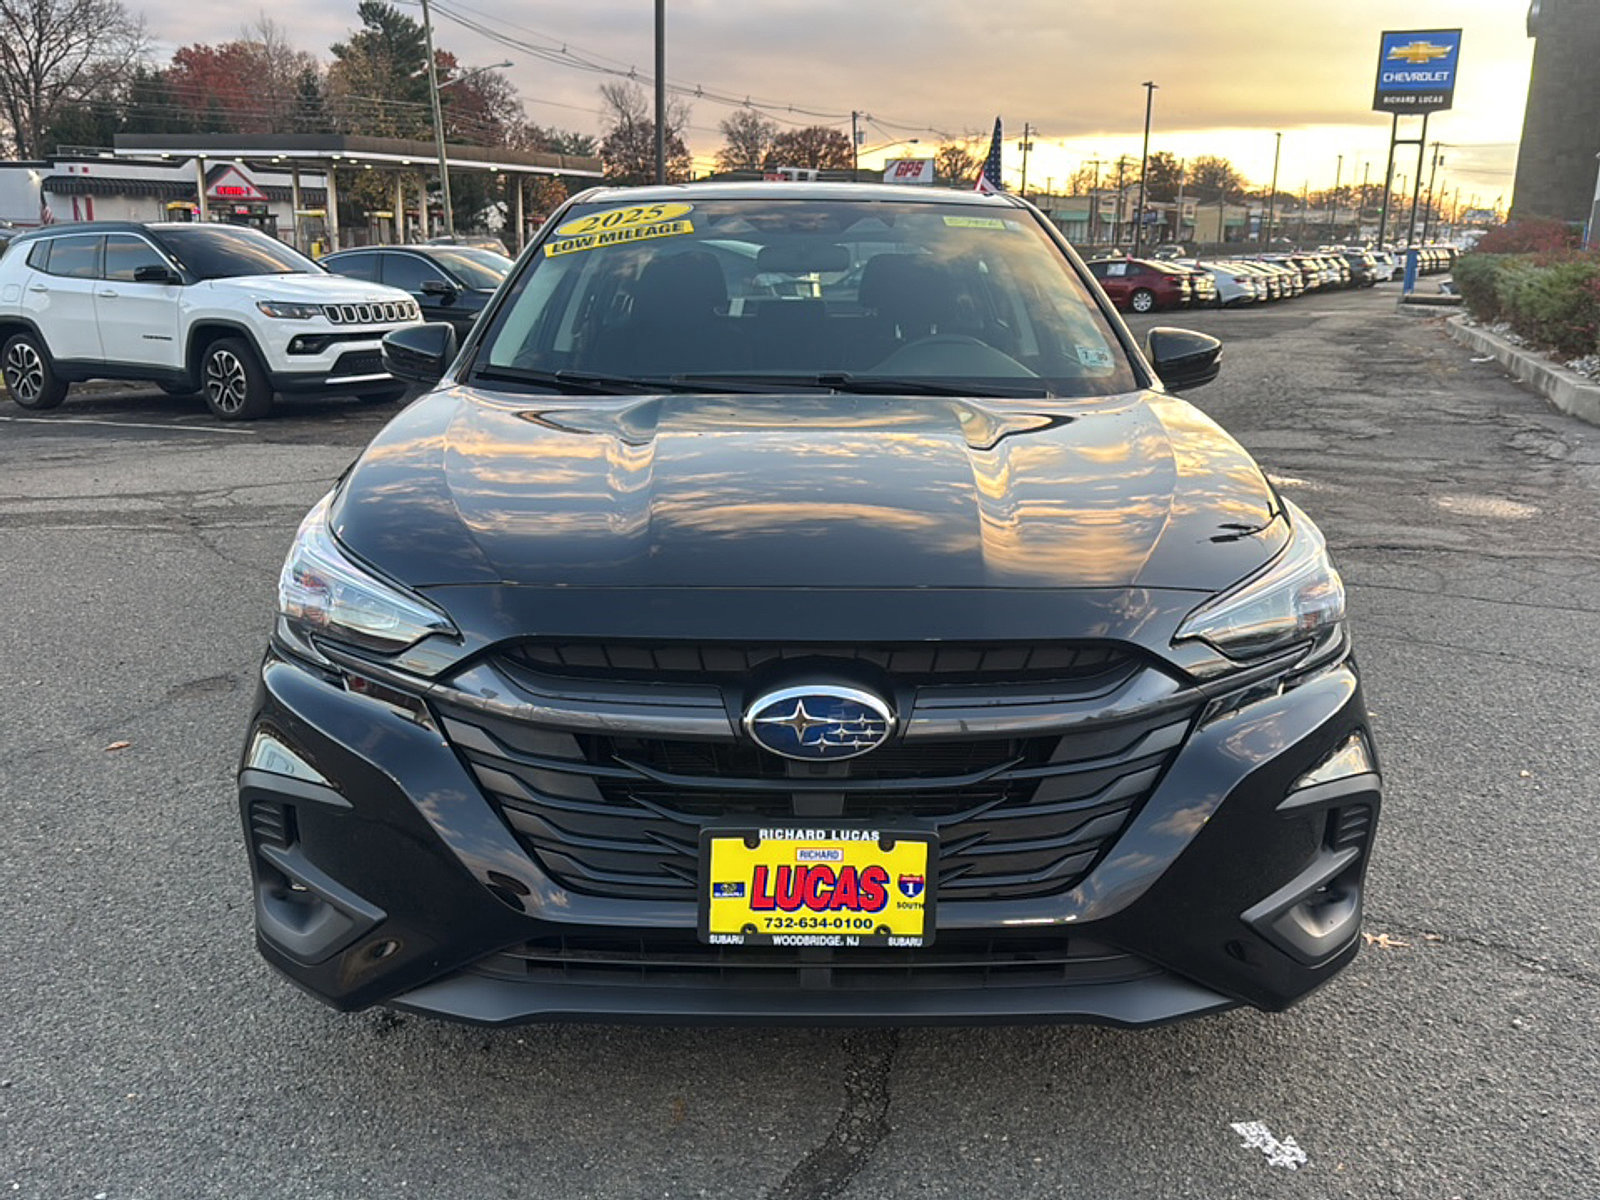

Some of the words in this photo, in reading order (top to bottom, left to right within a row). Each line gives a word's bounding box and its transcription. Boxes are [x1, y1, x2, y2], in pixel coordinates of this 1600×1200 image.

[1383, 71, 1450, 82] CHEVROLET
[1383, 96, 1416, 104] RICHARD
[1418, 95, 1443, 104] LUCAS
[577, 204, 663, 233] 2025
[552, 236, 592, 253] LOW
[598, 222, 685, 244] MILEAGE
[759, 828, 826, 840] RICHARD
[831, 829, 880, 841] LUCAS
[800, 850, 839, 860] RICHARD
[750, 864, 890, 913] LUCAS
[906, 883, 915, 896] 1
[896, 901, 925, 910] SOUTH
[764, 917, 873, 929] 732-634-0100
[709, 934, 745, 945] SUBARU
[846, 936, 860, 947] NJ
[888, 936, 923, 947] SUBARU
